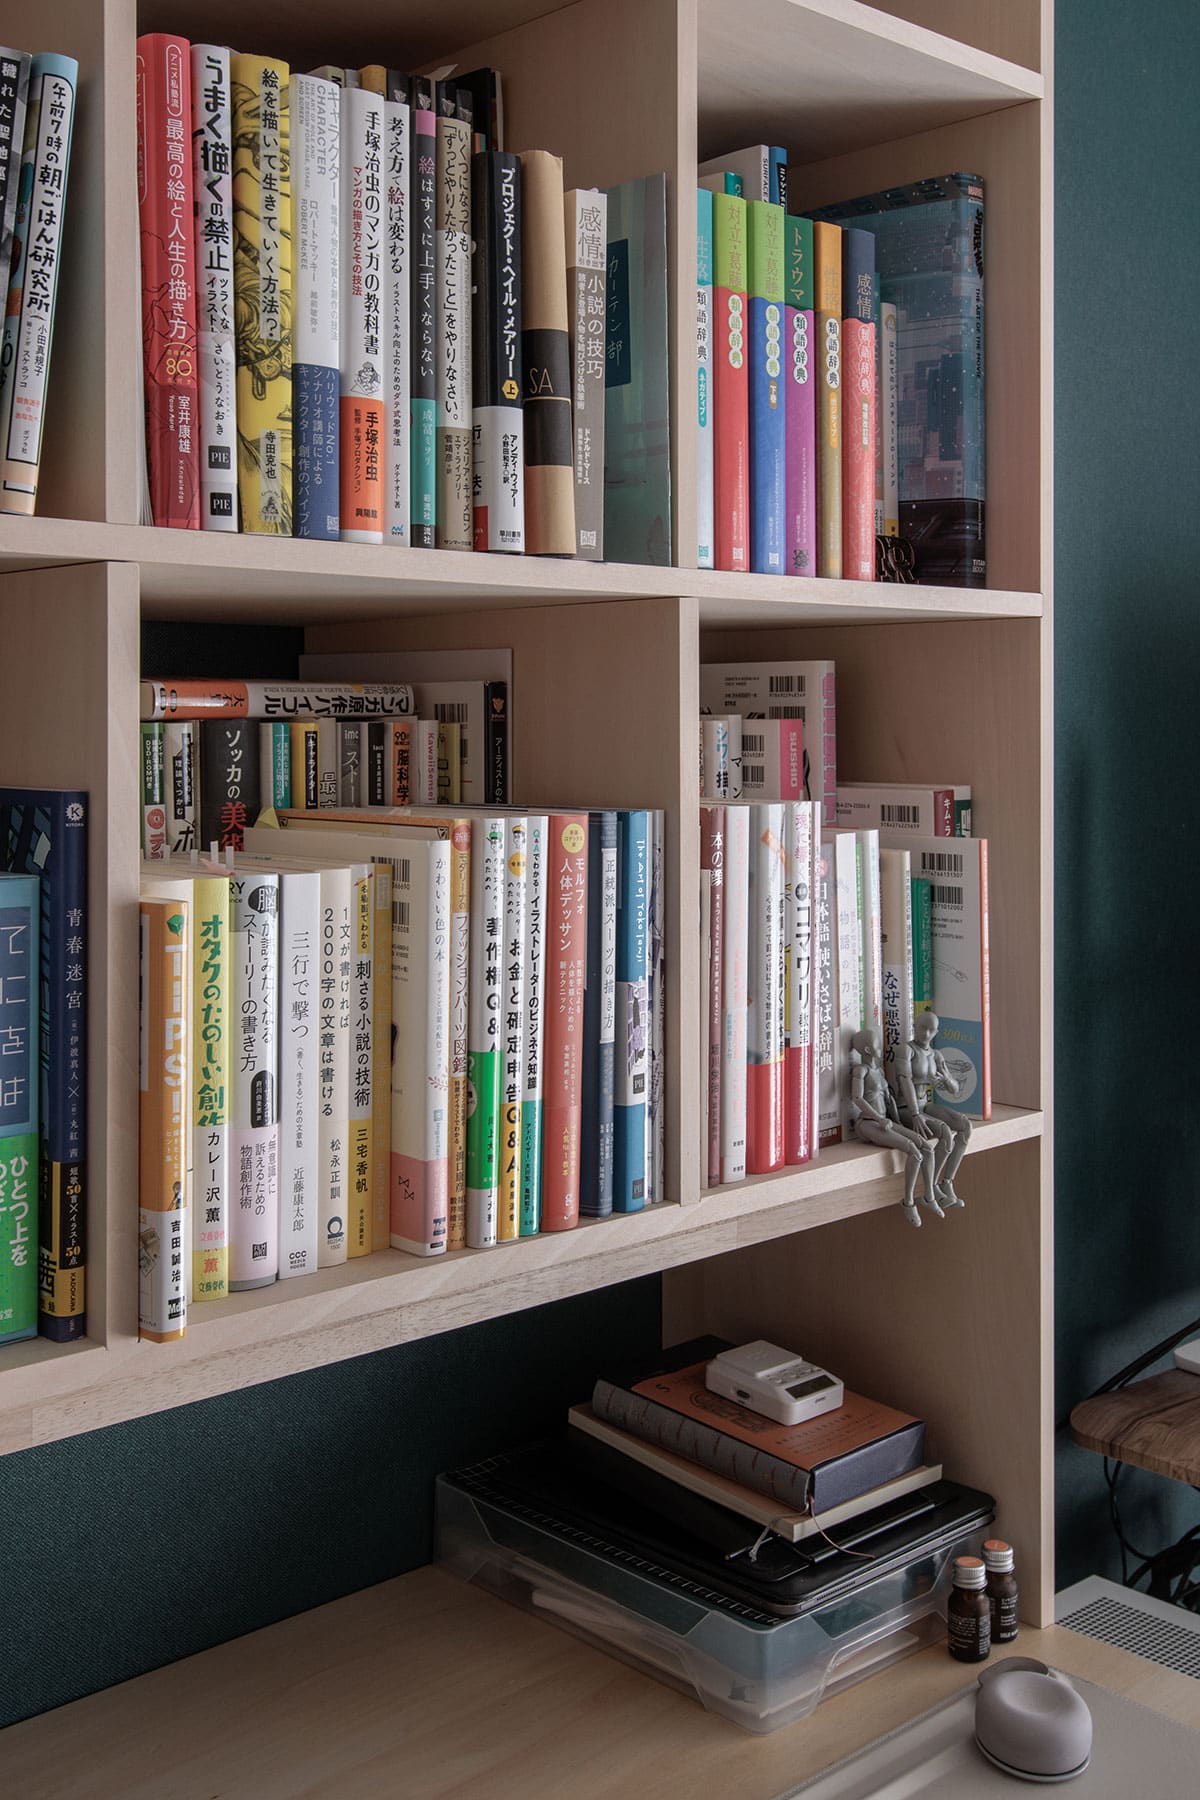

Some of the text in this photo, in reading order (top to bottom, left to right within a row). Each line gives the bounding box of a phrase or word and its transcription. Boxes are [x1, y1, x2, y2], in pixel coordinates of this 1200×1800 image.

[200, 55, 230, 272] うまく描くの禁止
[317, 85, 326, 176] CHARACTER
[327, 87, 340, 198] キャラクター
[26, 82, 67, 312] 午前7時の朝ごはん研究所
[166, 119, 187, 339] 最高の絵と人生の描き方
[301, 198, 309, 235] ROBERT
[352, 166, 363, 296] マンガの描き方とその技法
[363, 111, 381, 355] 手塚治虫のマンガの教科書
[387, 116, 405, 274] 考え方で絵は変わる
[457, 129, 471, 261] いくつになっても、
[578, 206, 602, 260] 感情
[219, 275, 230, 333] ツラくな
[418, 155, 435, 377] 絵はすぐに上手くならない
[443, 124, 459, 421] 「ずっとやりたかったこと」をやりなさい。
[501, 167, 517, 377] プロジェクト・ヘイル・メアリー
[790, 227, 807, 384] トラウマ 類語辞典
[857, 272, 872, 320] 感情
[34, 324, 48, 377] 小田真規子
[166, 358, 192, 376] 80
[586, 275, 604, 380] 小説の技巧
[729, 297, 741, 367] 類語辞典
[767, 307, 779, 377] 類語辞典
[826, 320, 840, 388] 類語辞典
[178, 395, 191, 454] 室井康雄
[213, 343, 225, 436] さいとうなおき
[312, 367, 323, 485] シナリオ講師による
[505, 382, 516, 395] 上
[529, 367, 554, 395] SA
[211, 449, 230, 464] PIE
[265, 430, 277, 480] 寺田克也
[297, 366, 310, 537] キャラクター創作のバイブル
[365, 410, 379, 482] 手塚治虫
[510, 434, 518, 508] アンディ・ウィアー
[213, 498, 231, 511] PIE
[264, 695, 409, 714] マンガ原作バイブル
[789, 731, 798, 788] SUSHIO
[434, 857, 447, 963] かわいい色の本
[559, 857, 573, 952] 人体デッサン
[575, 857, 585, 915] モルフォ
[66, 908, 83, 1009] 青春迷宮
[290, 930, 311, 1039] 三行で撃つ
[603, 859, 616, 1030] 正統派スーツの描き方
[197, 914, 224, 1126] オタクのたのしい創作
[240, 914, 258, 1073] ストーリーの書き方
[320, 907, 336, 1117] 2000字の文章は書ける
[354, 959, 372, 1107] 刺さる小説の技術
[453, 915, 469, 1074] ファッションパーツ図鑑
[528, 897, 541, 1090] イラストレーターのビジネス知識
[205, 1131, 221, 1224] カレー沢薫
[239, 1144, 253, 1209] 物語創作術
[254, 1142, 266, 1216] 訴えるための
[292, 1167, 305, 1232] 近藤康太郎
[329, 1138, 342, 1200] 松永正訓
[355, 1128, 369, 1194] 三宅香帆
[9, 1155, 29, 1267] ひとつ上を
[170, 1220, 182, 1283] 吉田誠治
[288, 1250, 307, 1260] CCC
